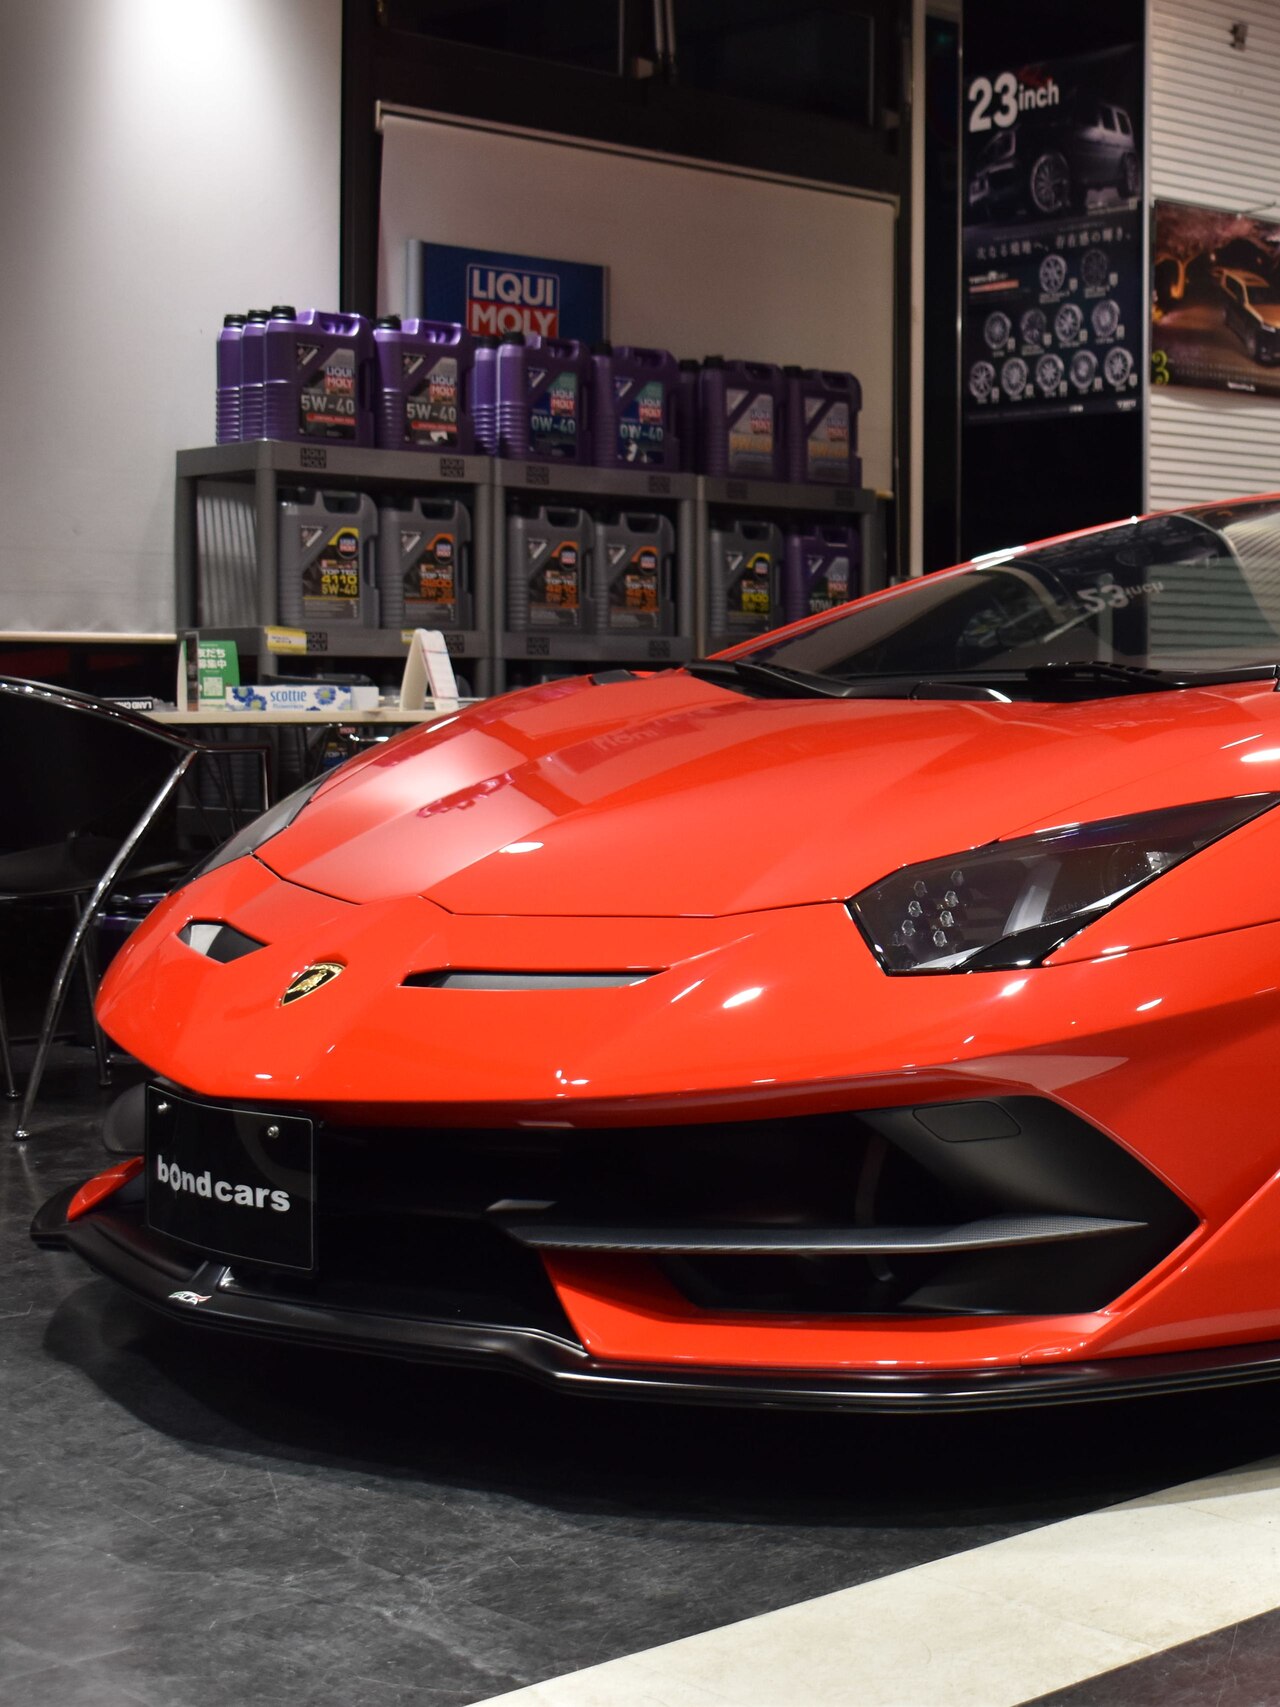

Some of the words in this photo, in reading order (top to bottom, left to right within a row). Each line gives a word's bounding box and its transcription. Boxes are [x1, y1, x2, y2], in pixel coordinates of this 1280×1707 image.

[472, 268, 554, 307] LIQUI
[472, 303, 557, 338] MOLY
[326, 366, 354, 377] LIQUI
[326, 376, 354, 388] MOLY
[431, 374, 456, 386] LIQUI
[431, 385, 456, 396] MOLY
[300, 394, 355, 415] 5W-40
[551, 398, 575, 410] MOLY
[406, 402, 457, 422] 5W-40
[640, 407, 662, 418] MOLY
[531, 415, 576, 434] 0W-40
[620, 423, 664, 442] 0W-40
[321, 575, 358, 584] 4110
[322, 584, 358, 595] 5W-40
[270, 690, 307, 702] scottie
